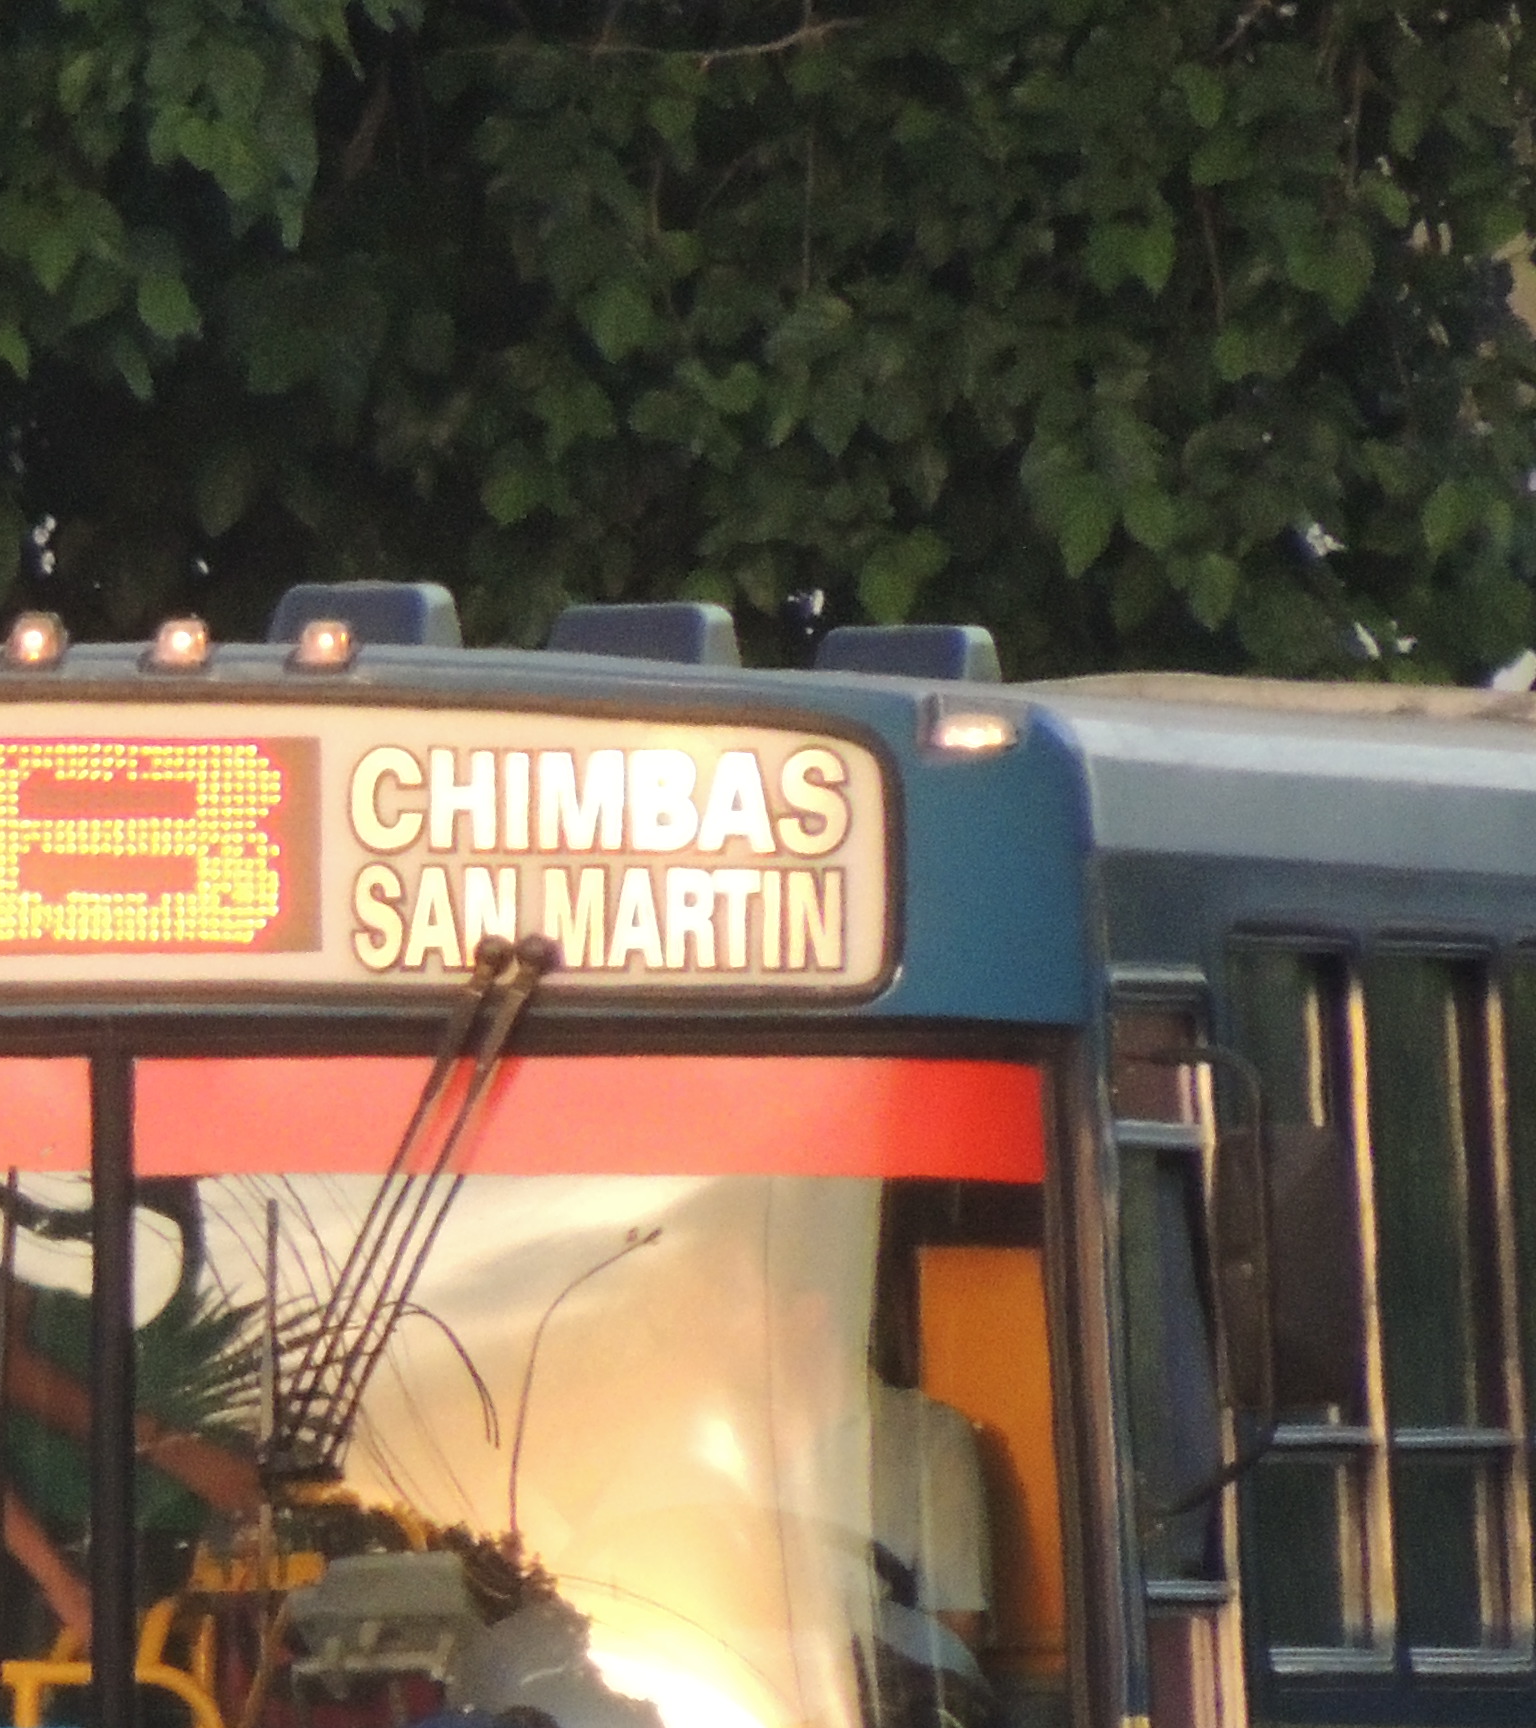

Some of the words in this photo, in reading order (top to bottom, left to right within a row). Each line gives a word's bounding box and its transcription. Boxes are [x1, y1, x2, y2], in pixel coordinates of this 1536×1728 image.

[347, 743, 854, 858] CHIMBAS
[350, 861, 519, 975] SAN
[538, 862, 845, 974] MARTIN
